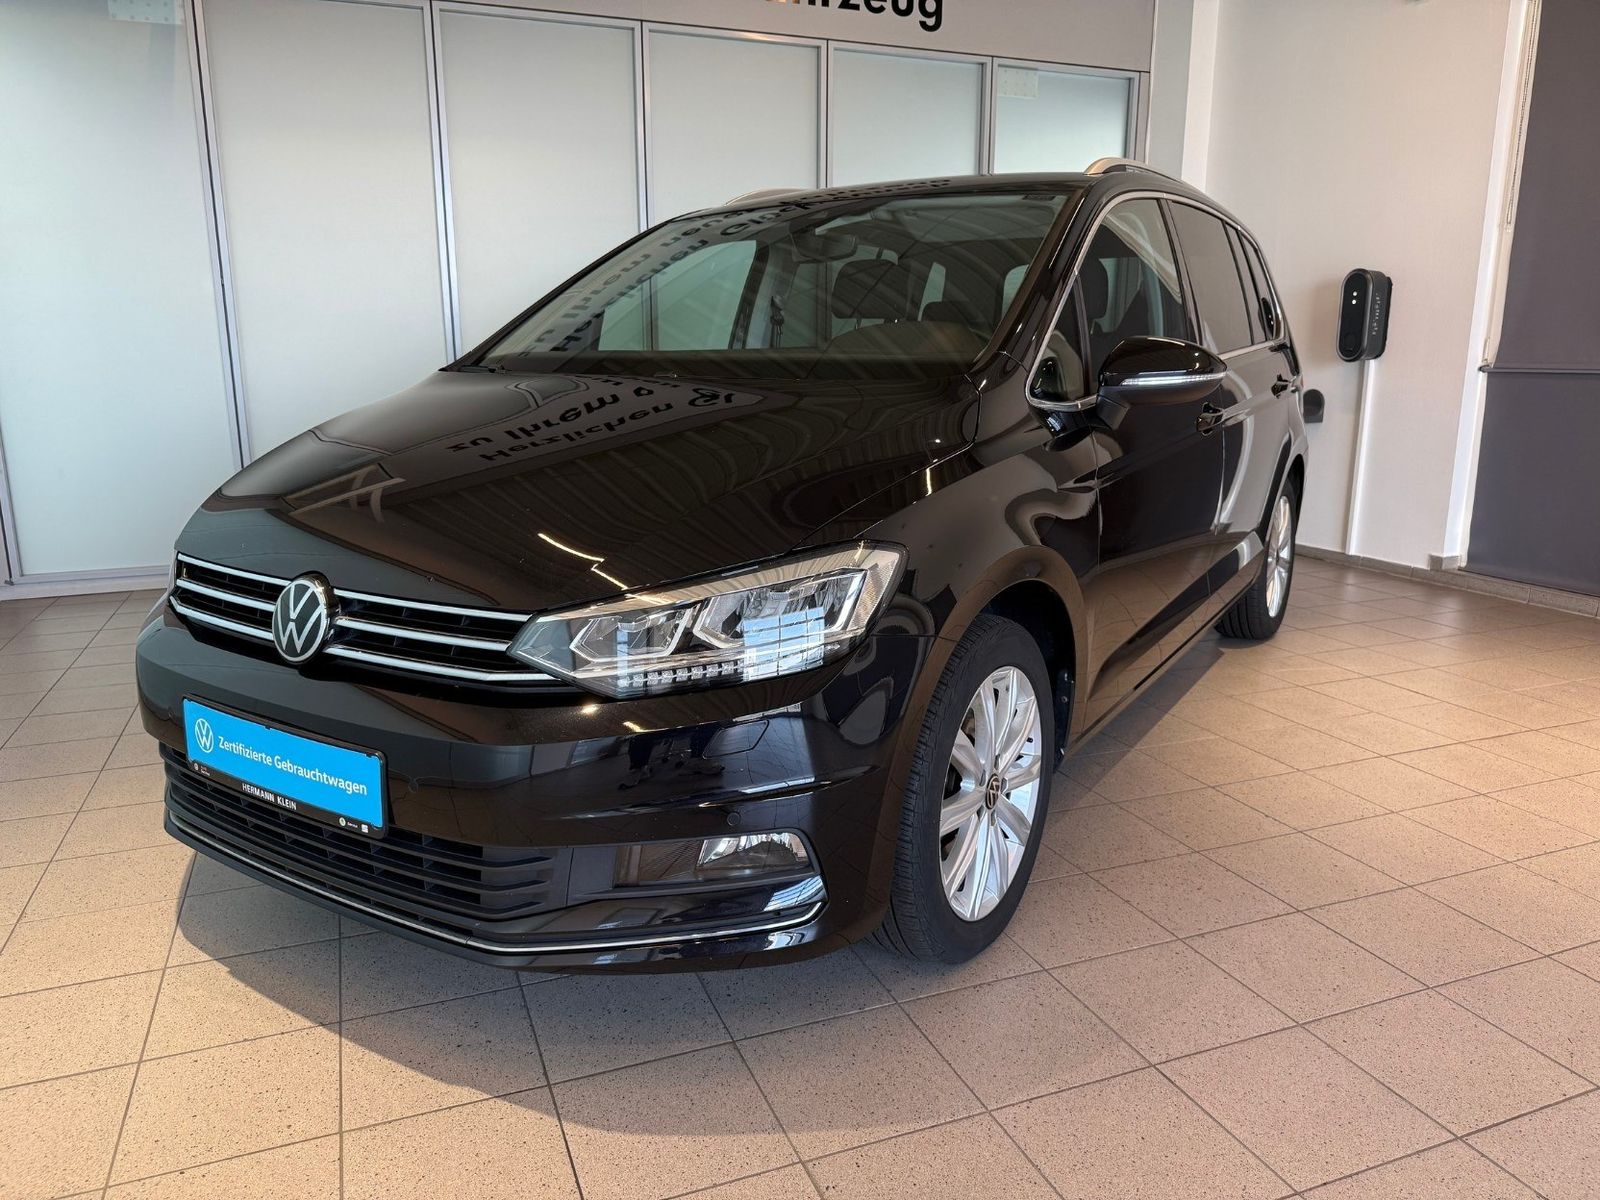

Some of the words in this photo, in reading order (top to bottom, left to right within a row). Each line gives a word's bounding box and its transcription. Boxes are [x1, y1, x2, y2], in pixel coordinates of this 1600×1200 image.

[218, 735, 273, 767] Zertifizierte
[274, 755, 368, 796] Gebrauchtwagen
[242, 782, 275, 803] HERMANN
[277, 796, 297, 811] KLEIN
